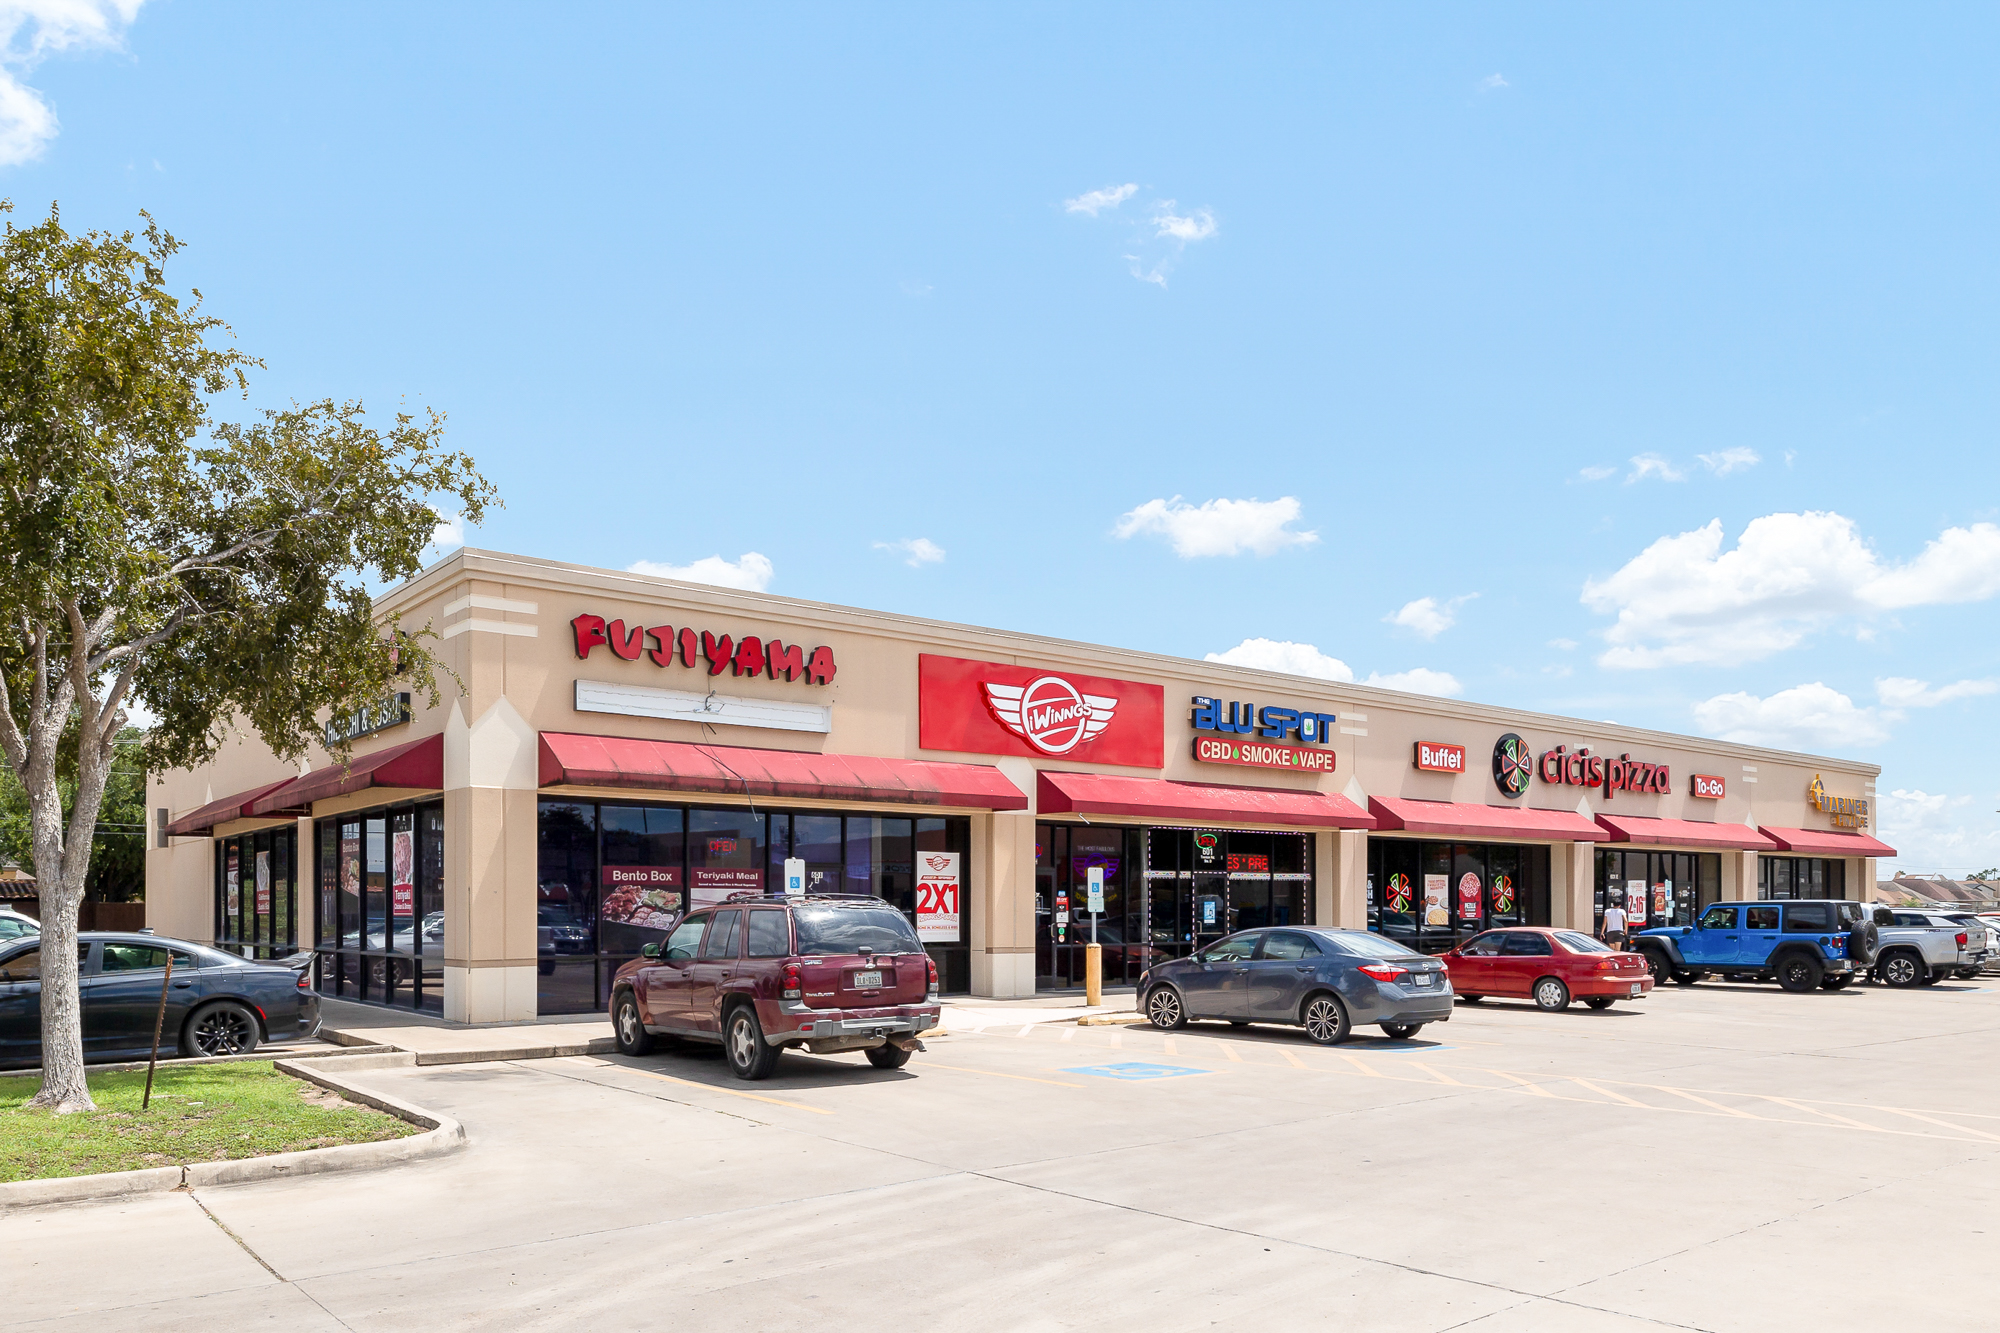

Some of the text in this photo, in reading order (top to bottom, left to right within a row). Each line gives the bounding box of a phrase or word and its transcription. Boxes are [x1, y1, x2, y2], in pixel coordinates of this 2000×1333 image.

[570, 613, 837, 685] FUJIYAMA
[1197, 697, 1210, 705] THE
[1192, 696, 1336, 744] BLU SPOT
[1200, 740, 1333, 770] CBD SMOKE VAPE
[1421, 746, 1462, 769] Buffet
[1539, 745, 1671, 799] cicis pizza
[1696, 777, 1723, 796] To-Go
[1820, 796, 1868, 815] MARINER
[709, 840, 737, 851] OPEN
[1197, 836, 1216, 847] OPEN
[1202, 847, 1213, 855] 601
[613, 870, 673, 882] Bento Box
[697, 871, 758, 881] Teriyaki Meal
[395, 889, 411, 902] Teriyaki
[916, 883, 958, 914] 2X1
